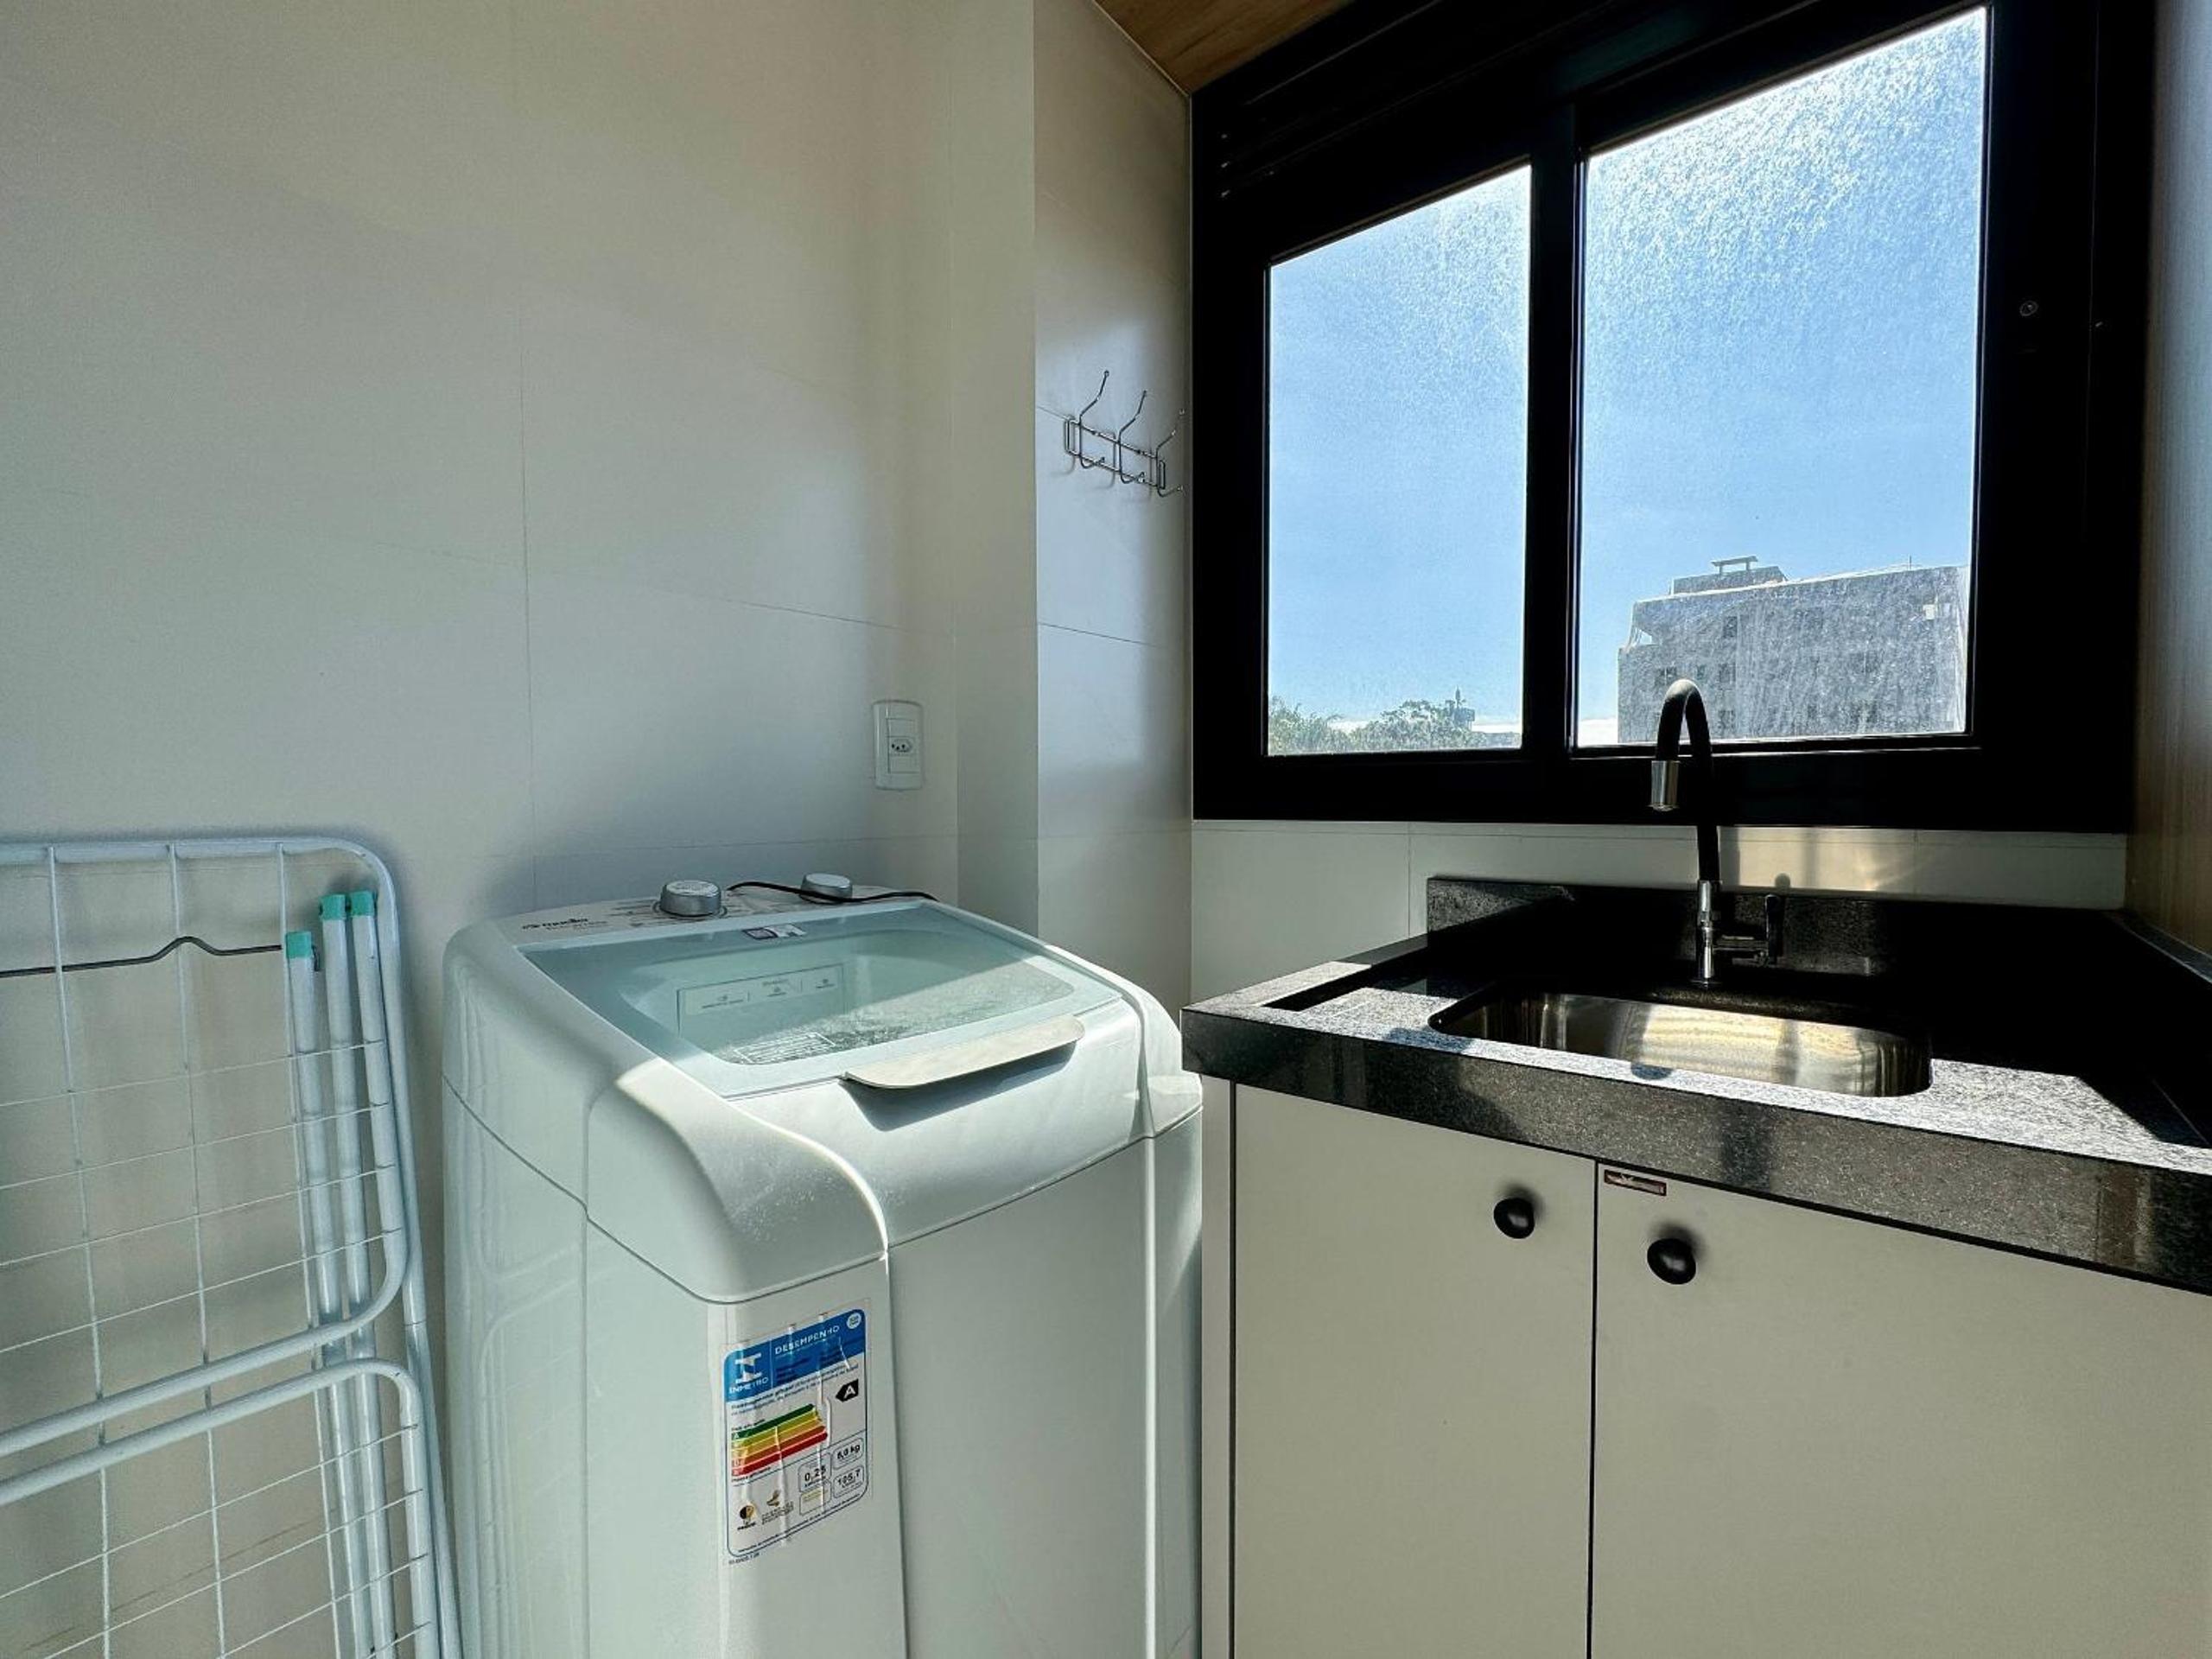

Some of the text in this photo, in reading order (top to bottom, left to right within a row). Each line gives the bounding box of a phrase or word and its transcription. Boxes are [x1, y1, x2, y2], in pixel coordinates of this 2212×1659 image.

[775, 1325, 840, 1355] DESEMPENHO
[728, 1376, 769, 1394] INMETRO
[843, 1385, 856, 1399] A
